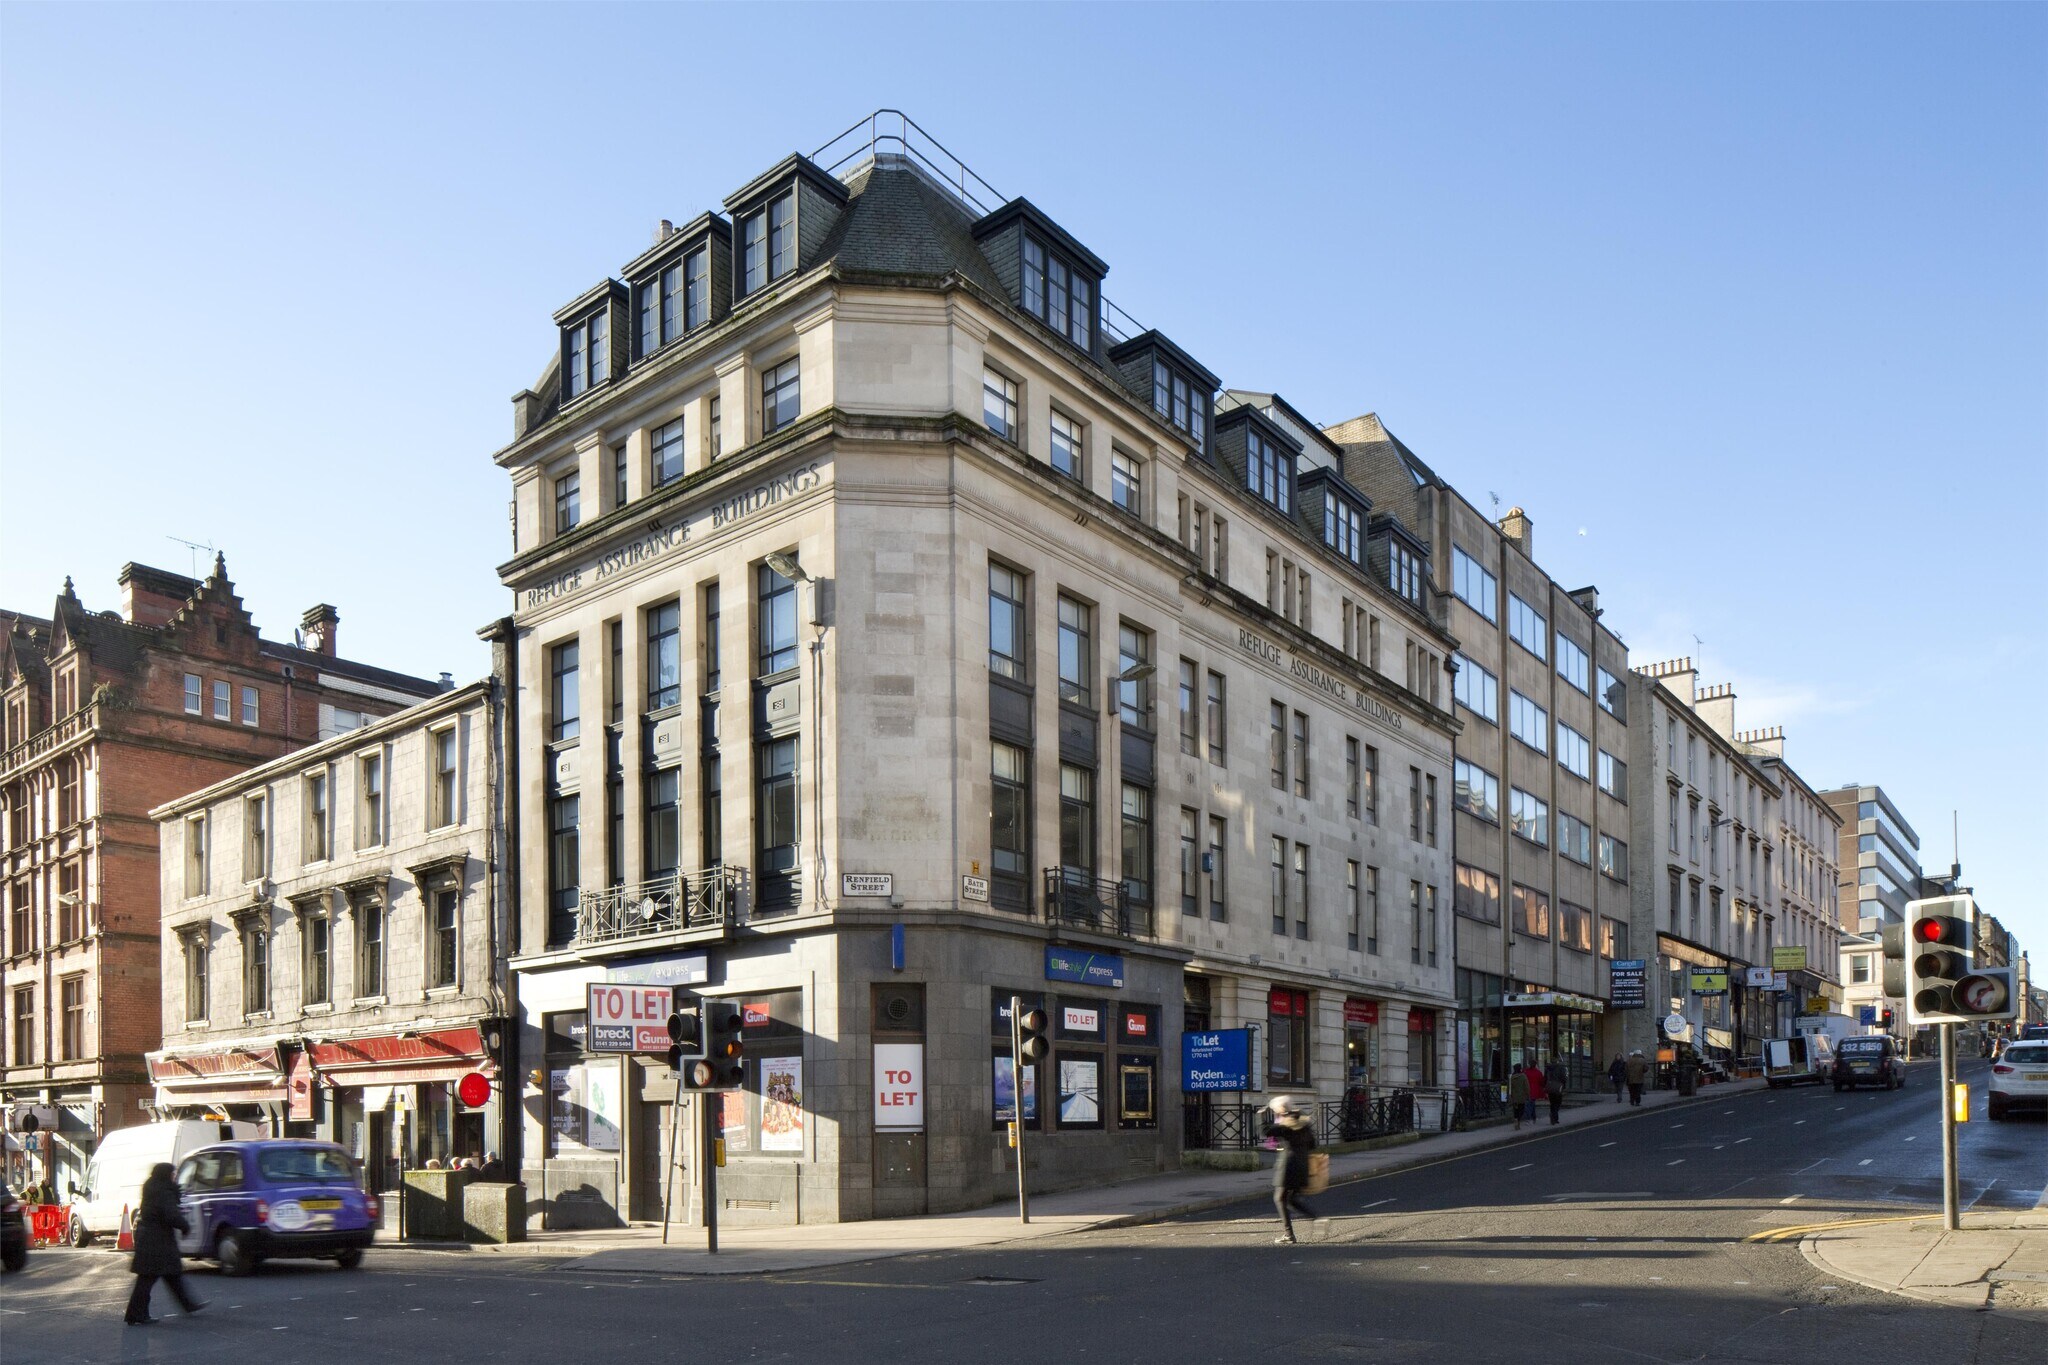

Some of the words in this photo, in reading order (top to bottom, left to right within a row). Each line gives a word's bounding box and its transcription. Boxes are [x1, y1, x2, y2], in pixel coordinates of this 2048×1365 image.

[527, 568, 583, 609] REFUGE
[595, 519, 692, 581] ASSURANCE
[712, 462, 821, 529] BUILDINGS
[1239, 628, 1281, 666] REFUGE
[1290, 657, 1346, 700] ASSURANCE
[1356, 691, 1403, 729] BUILDINGS
[846, 875, 890, 883] RENFIELD
[967, 878, 984, 888] BATH
[850, 883, 886, 891] STREET
[964, 885, 987, 897] STREET
[655, 964, 690, 979] express
[1058, 959, 1083, 974] lifestyle
[1088, 966, 1114, 977] express
[593, 988, 624, 1020] TO
[631, 990, 671, 1020] LET
[745, 1009, 768, 1023] Gunn
[999, 1006, 1012, 1017] bre
[1067, 1013, 1078, 1024] TO
[1080, 1014, 1095, 1025] LET
[1128, 1018, 1146, 1032] Gunn
[571, 1024, 588, 1035] breck
[595, 1026, 631, 1040] breck
[639, 1031, 670, 1045] Gunn
[338, 1041, 361, 1061] THE
[368, 1039, 394, 1058] BAY
[399, 1034, 444, 1056] HORSE
[1841, 1043, 1858, 1052] 332
[193, 1057, 215, 1074] BAY
[885, 1070, 912, 1085] TO
[1219, 1080, 1238, 1088] 3838
[880, 1092, 918, 1106] LET
